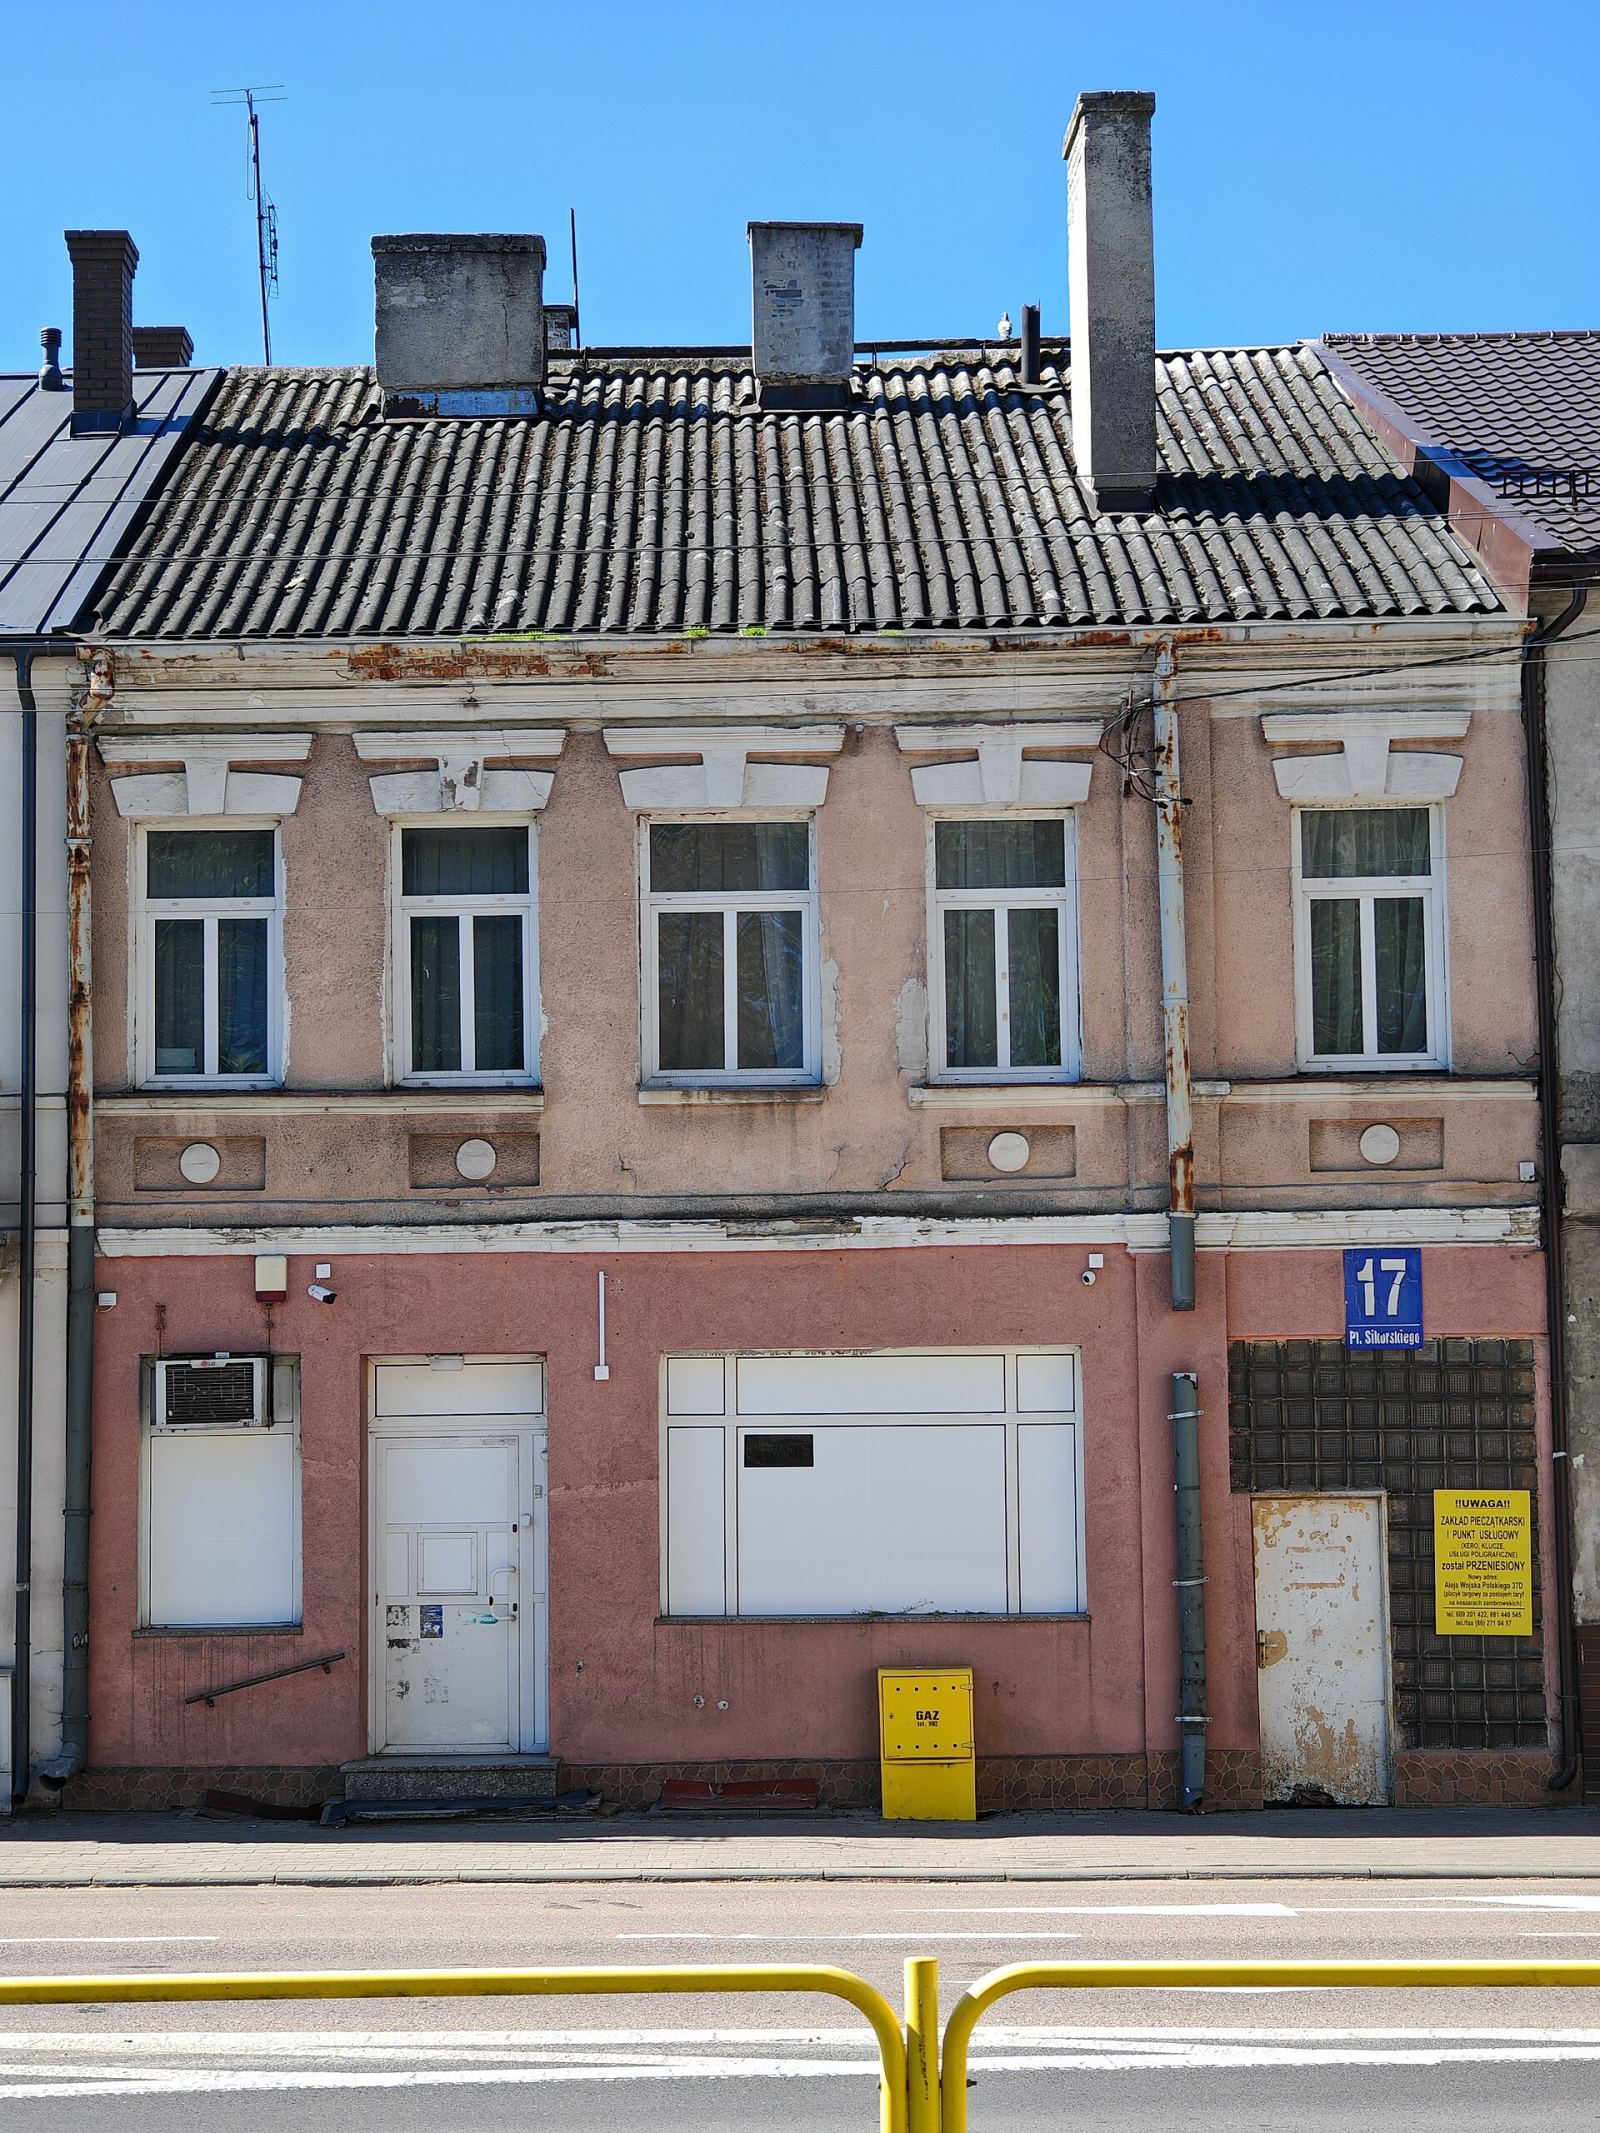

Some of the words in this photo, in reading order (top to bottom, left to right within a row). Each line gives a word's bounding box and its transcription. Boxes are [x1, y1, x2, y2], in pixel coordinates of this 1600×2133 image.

[1357, 1258, 1406, 1316] 17
[1365, 1329, 1420, 1345] Sikorskiego
[1455, 1499, 1510, 1508] !!UWAGA!!
[1441, 1515, 1468, 1526] ZAKŁAD
[1470, 1516, 1525, 1528] PIECZĄTKARSKI
[1453, 1530, 1475, 1539] PUNKT
[1479, 1530, 1519, 1540] USŁUGOWY
[1466, 1560, 1525, 1571] PRZENIESIONY
[1445, 1582, 1458, 1590] Aleja
[1459, 1581, 1481, 1590] Wojska
[1482, 1582, 1510, 1591] Polskiego
[916, 1711, 940, 1720] GAZ
